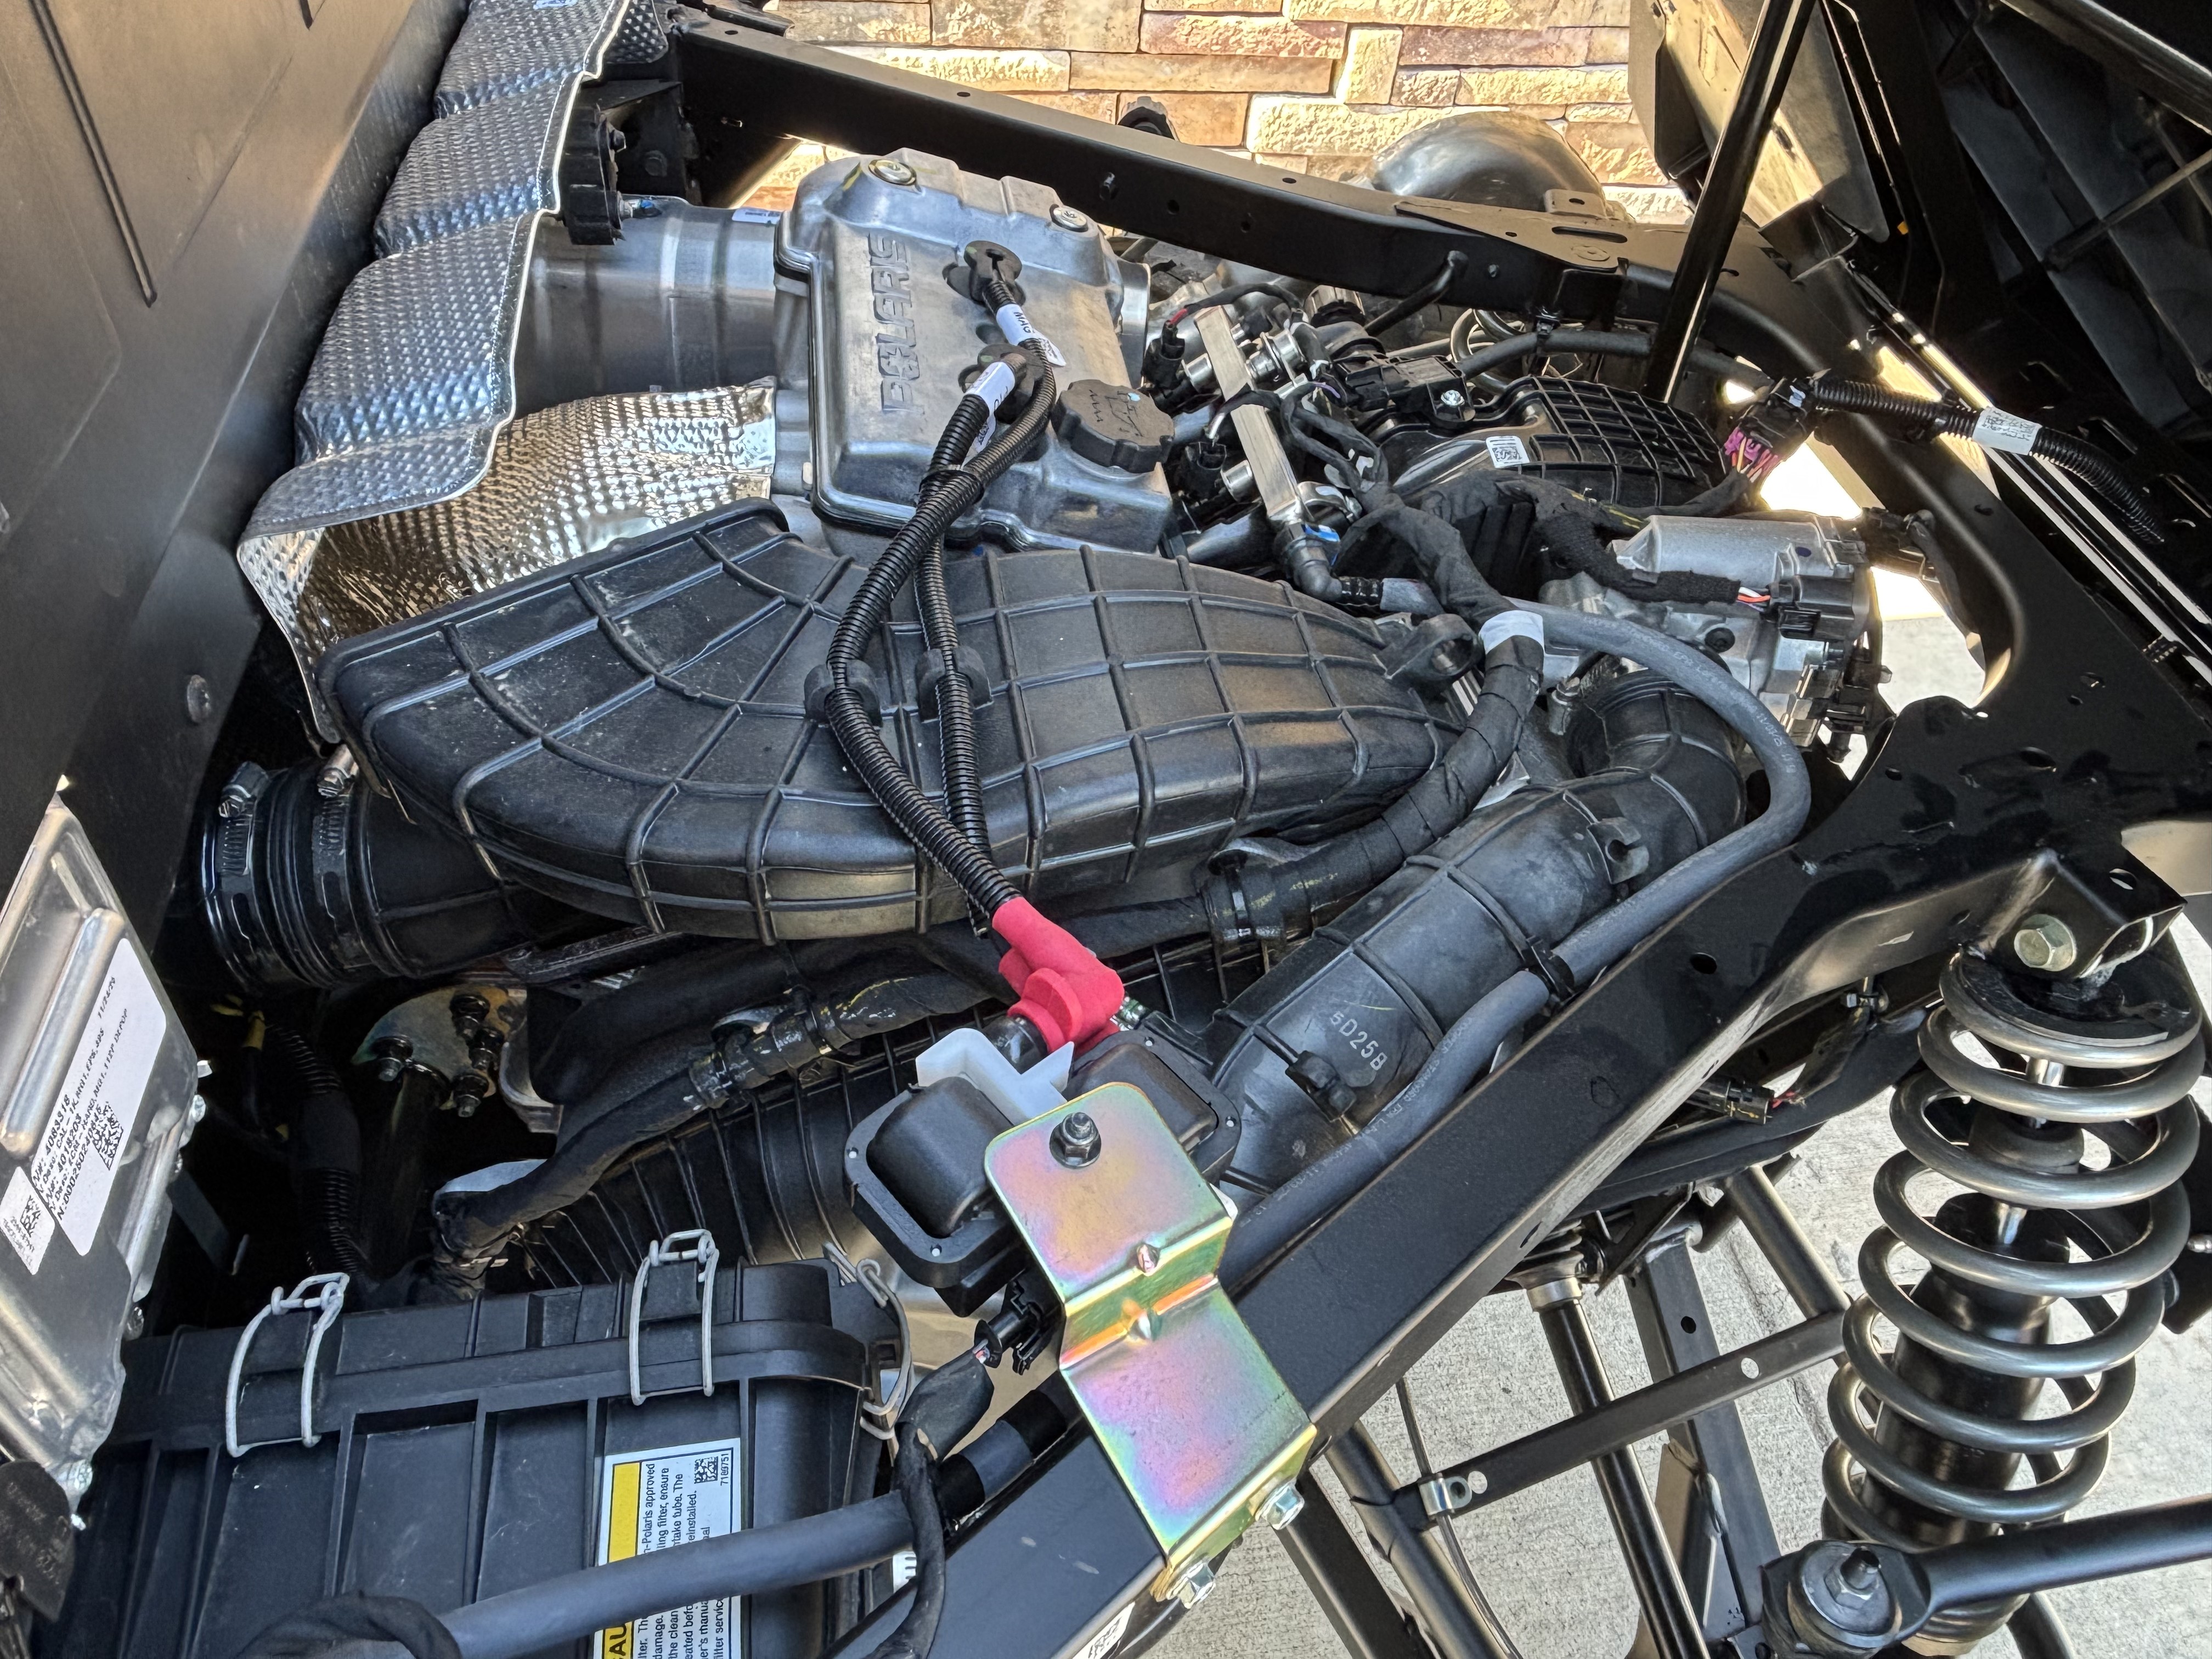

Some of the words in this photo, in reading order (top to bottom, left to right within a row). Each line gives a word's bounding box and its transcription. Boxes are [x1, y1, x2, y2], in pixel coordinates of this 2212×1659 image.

[868, 233, 921, 414] POLARIS
[645, 1464, 656, 1508] approved
[660, 1468, 669, 1500] ensure
[668, 1611, 678, 1639] clean
[673, 1474, 683, 1493] The
[609, 1625, 627, 1659] AU
